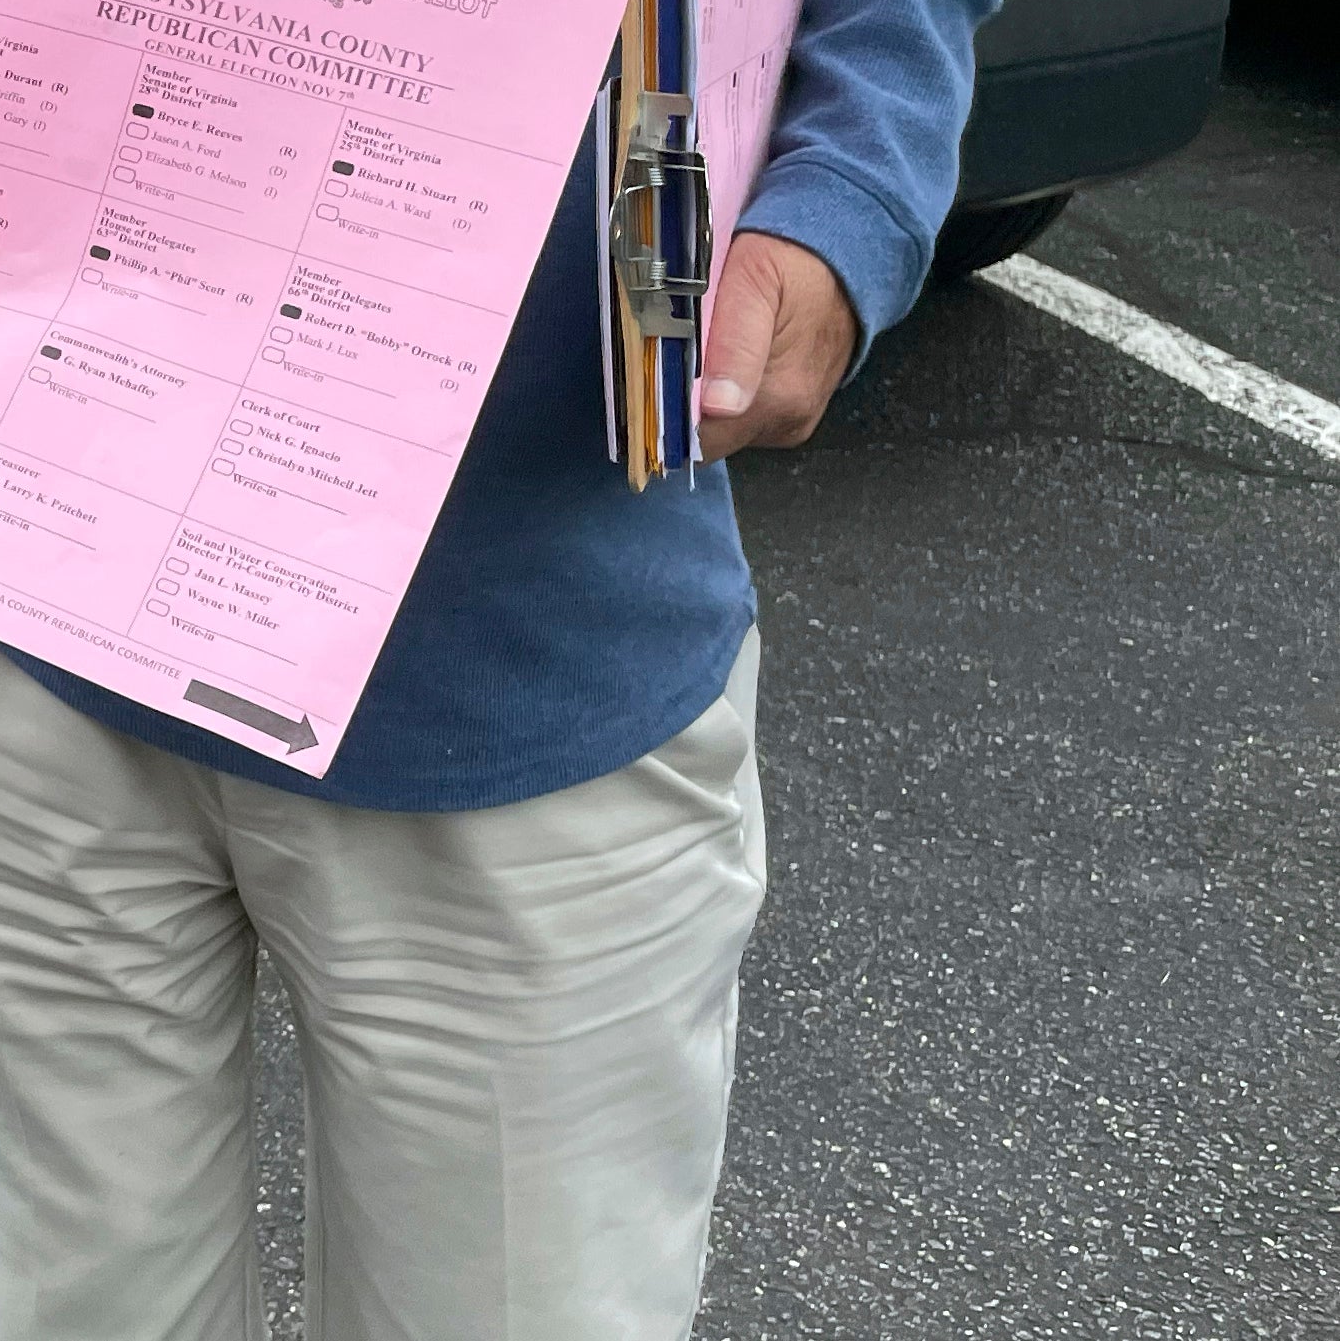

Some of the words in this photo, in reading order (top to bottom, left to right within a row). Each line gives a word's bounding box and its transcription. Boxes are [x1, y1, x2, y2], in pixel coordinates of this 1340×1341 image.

[143, 37, 217, 68] GENERAL
[219, 58, 297, 89] ELECTION
[300, 80, 335, 102] NOV
[319, 28, 434, 74] COUNTY
[3, 69, 43, 88] Durant
[50, 82, 69, 96] (R)
[267, 45, 435, 106] COMMITTEE
[156, 110, 190, 129] Bryce
[205, 123, 244, 142] Reeves
[278, 145, 299, 161] (R)
[357, 167, 404, 189] Richard
[420, 185, 457, 204] Stuart
[467, 199, 489, 215] (R)
[197, 280, 226, 297] Scott
[303, 312, 344, 332] Robert
[410, 344, 453, 366] Orrock
[457, 360, 478, 375] (R)
[139, 363, 187, 389] Attorney
[240, 398, 272, 417] Clerk
[287, 414, 321, 433] Court
[256, 426, 283, 443] Nick
[299, 440, 342, 464] Ignacio
[247, 445, 305, 474] Christalyn
[307, 466, 355, 490] Mitchell
[354, 482, 379, 499] Jett
[175, 537, 223, 563] Director
[315, 590, 360, 614] District
[179, 527, 203, 544] Soil
[203, 538, 226, 552] and
[227, 544, 263, 566] Water
[263, 560, 339, 595] Conservation
[187, 587, 225, 611] Wayne
[245, 609, 281, 630] Miller
[193, 568, 215, 584] Jan
[231, 582, 273, 606] Massey
